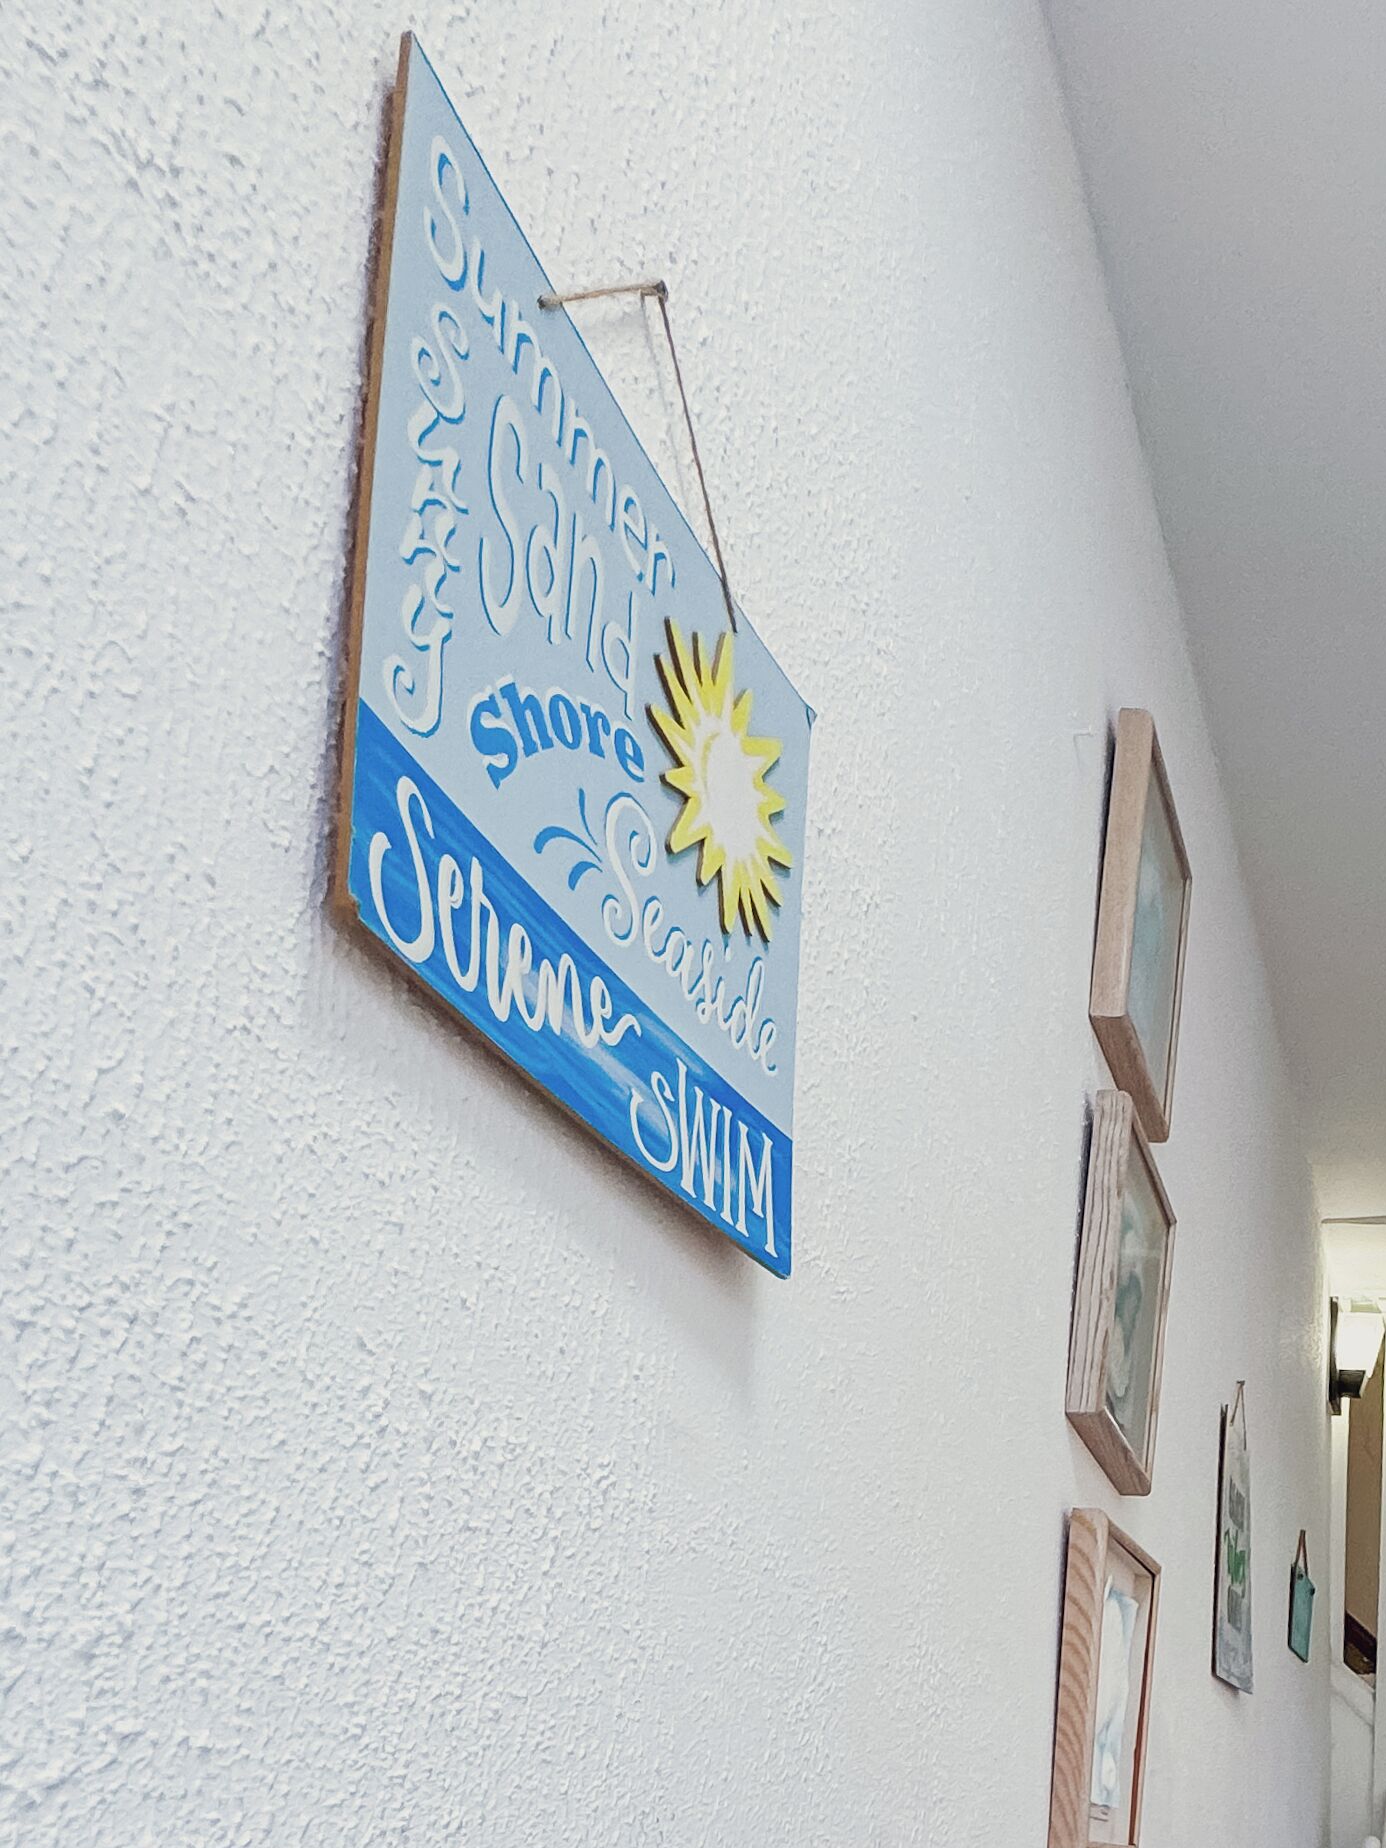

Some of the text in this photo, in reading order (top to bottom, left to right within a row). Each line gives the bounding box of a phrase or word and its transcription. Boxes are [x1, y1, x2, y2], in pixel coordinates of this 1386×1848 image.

[383, 303, 470, 738] Sunny
[423, 134, 677, 596] Summer
[479, 394, 643, 719] Sand
[368, 775, 643, 1049] Serene
[601, 790, 780, 1075] Seaside
